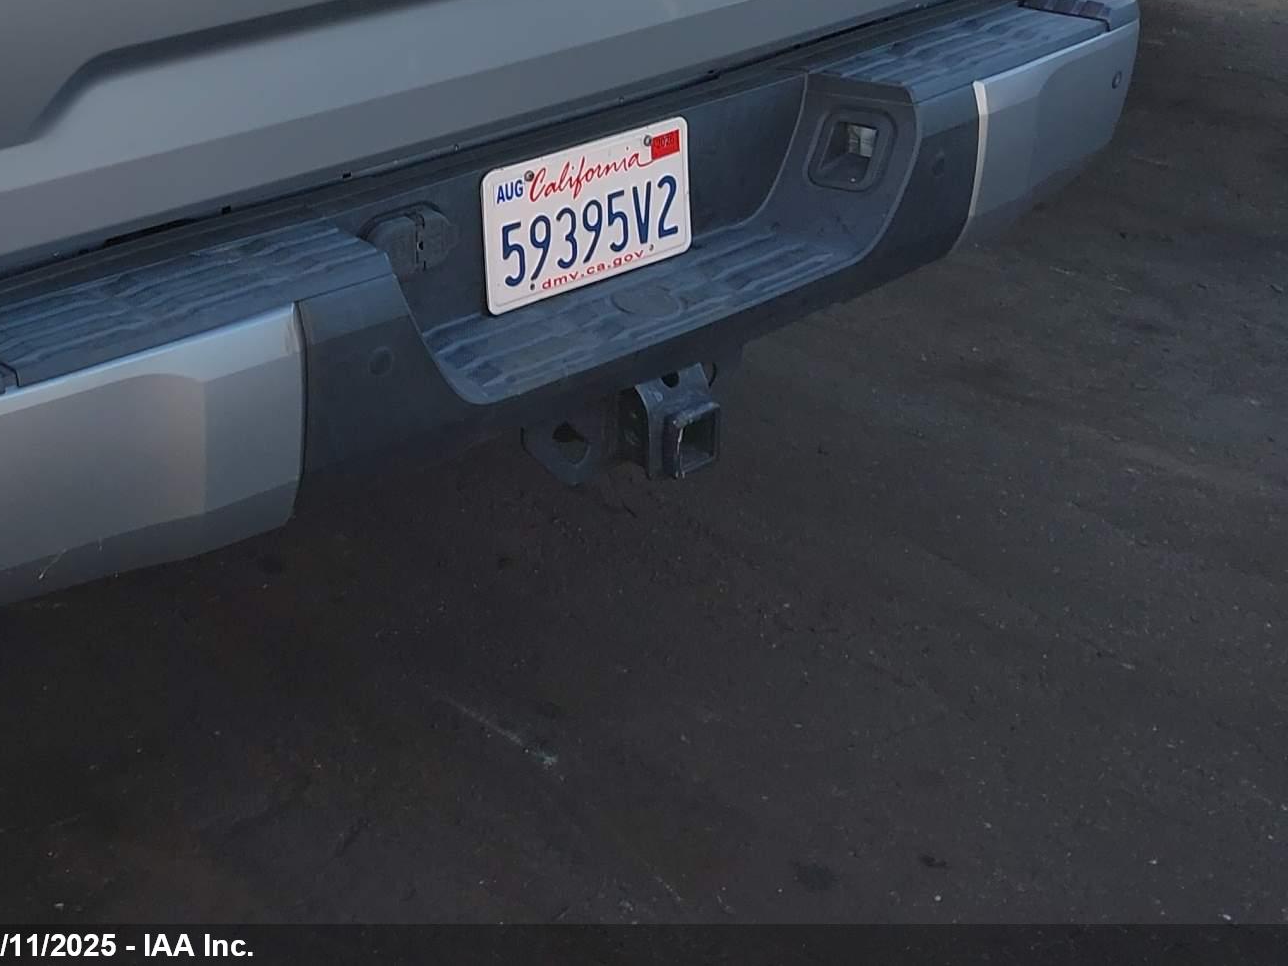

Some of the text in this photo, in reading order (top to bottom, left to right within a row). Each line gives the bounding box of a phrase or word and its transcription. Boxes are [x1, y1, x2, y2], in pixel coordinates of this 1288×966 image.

[496, 179, 524, 204] AUG
[528, 146, 653, 202] California
[501, 174, 679, 287] 59395V2
[541, 249, 644, 291] dmv.ca.gov
